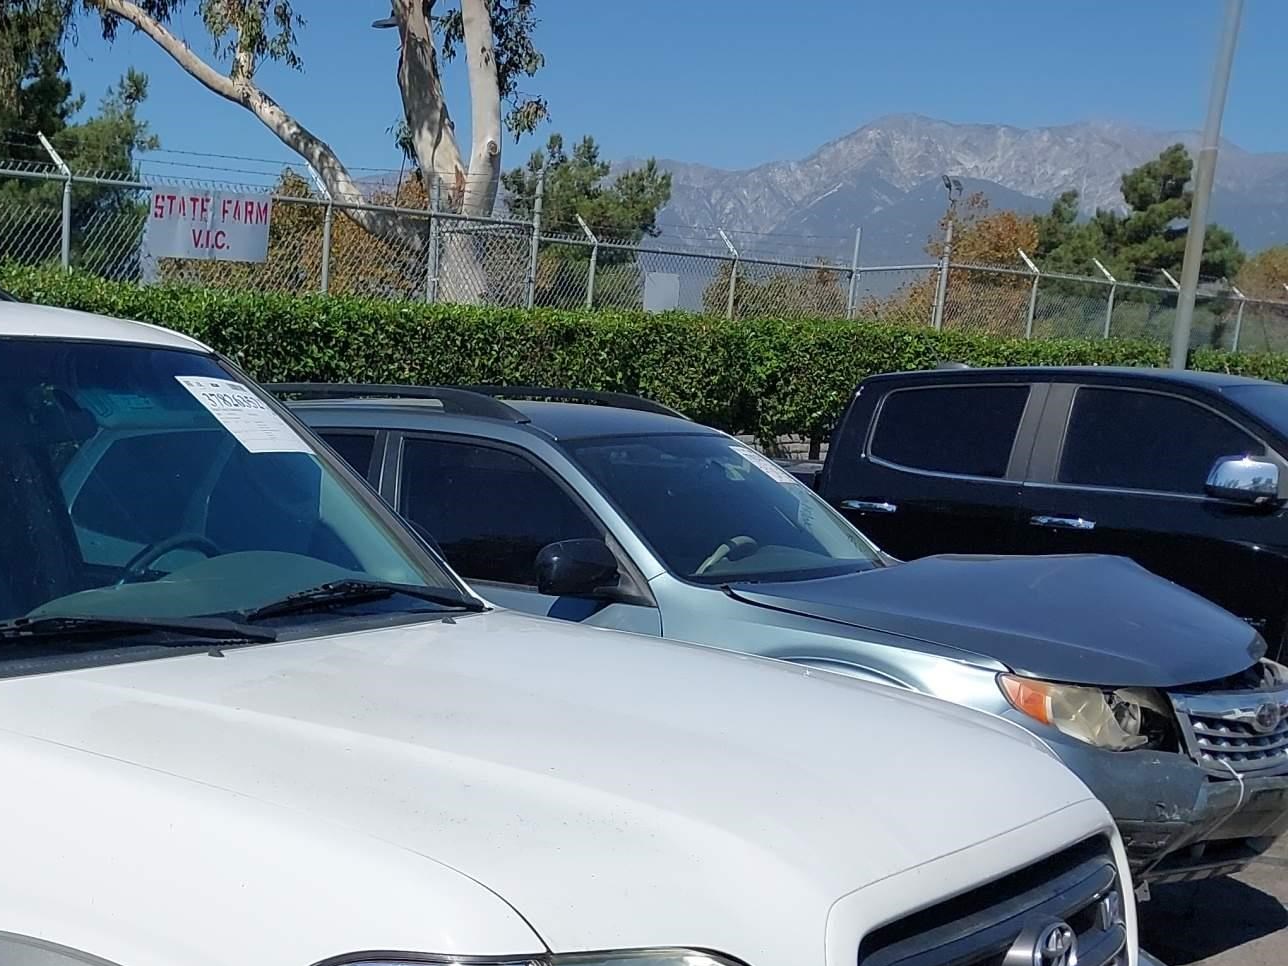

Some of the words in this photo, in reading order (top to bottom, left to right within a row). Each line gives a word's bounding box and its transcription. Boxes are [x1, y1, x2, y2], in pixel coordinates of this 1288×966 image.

[153, 194, 211, 222] STATE
[221, 199, 269, 225] FARM
[191, 228, 230, 250] V.I.C.
[201, 392, 265, 410] 37826352
